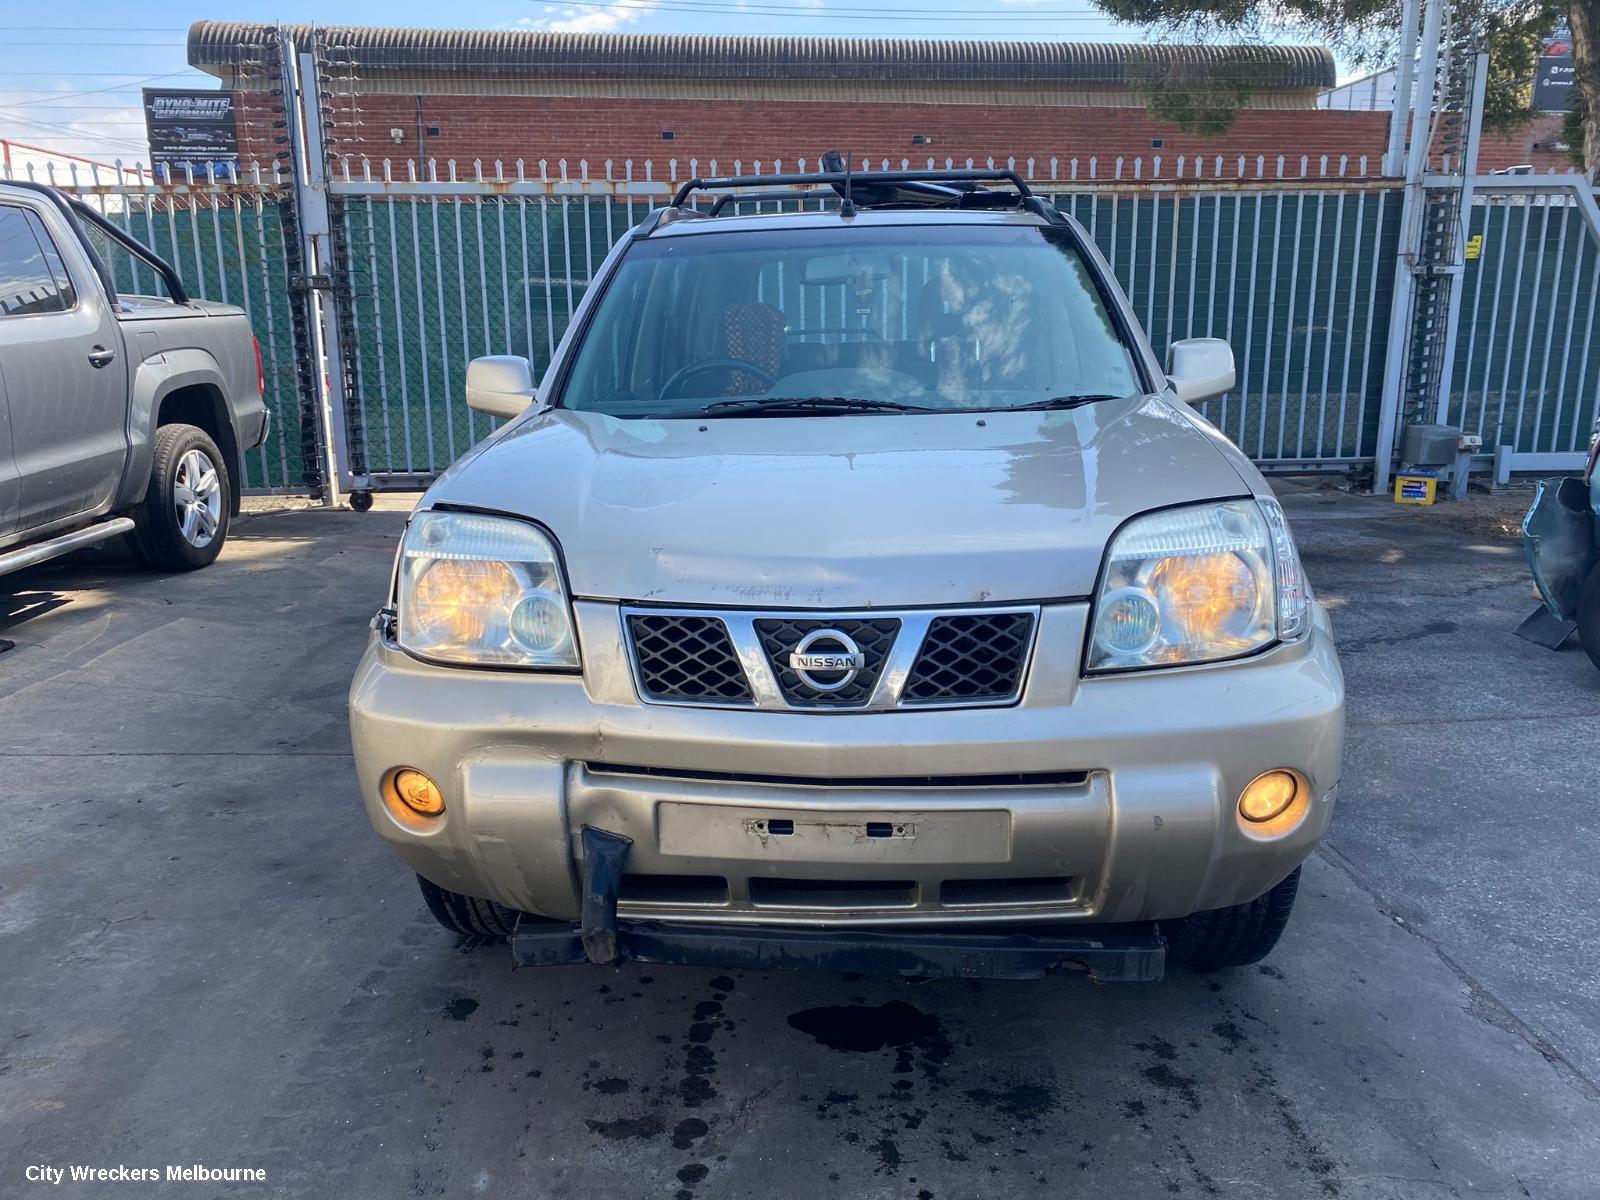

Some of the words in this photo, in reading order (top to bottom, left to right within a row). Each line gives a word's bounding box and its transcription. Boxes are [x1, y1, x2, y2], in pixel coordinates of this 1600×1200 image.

[155, 99, 228, 110] DYNO-MITE
[156, 109, 223, 117] PERFORMANCE
[797, 657, 856, 667] NISSAN
